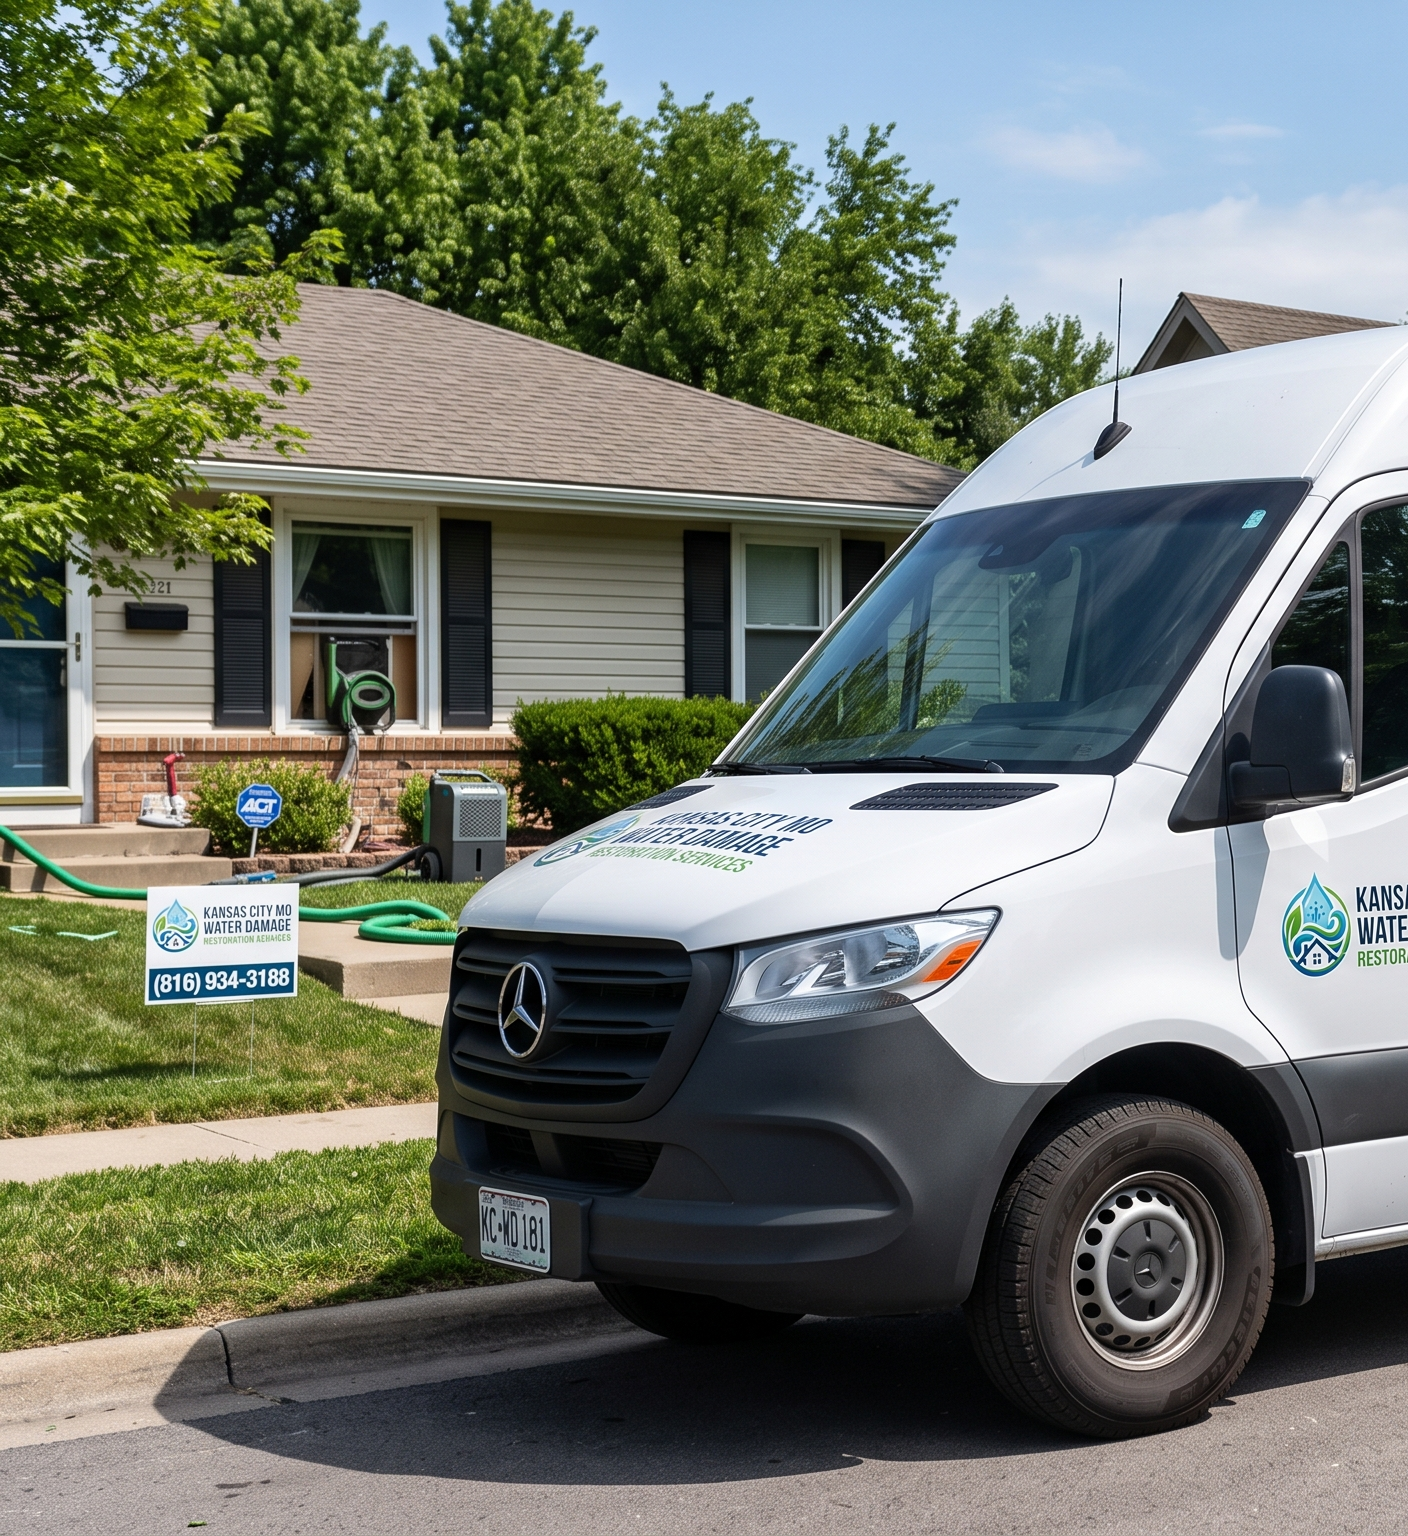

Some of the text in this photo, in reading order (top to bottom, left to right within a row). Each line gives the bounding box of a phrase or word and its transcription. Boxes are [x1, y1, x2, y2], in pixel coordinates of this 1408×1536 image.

[649, 811, 833, 834] KANSAS CITY MO
[610, 827, 795, 857] WATER DAMAGE
[672, 850, 753, 873] SERVICES
[203, 903, 292, 919] KANSAS CITY MO
[203, 918, 291, 935] WATER DAMAGE
[153, 967, 290, 998] (816) 934-3188
[522, 1213, 545, 1254] 181
